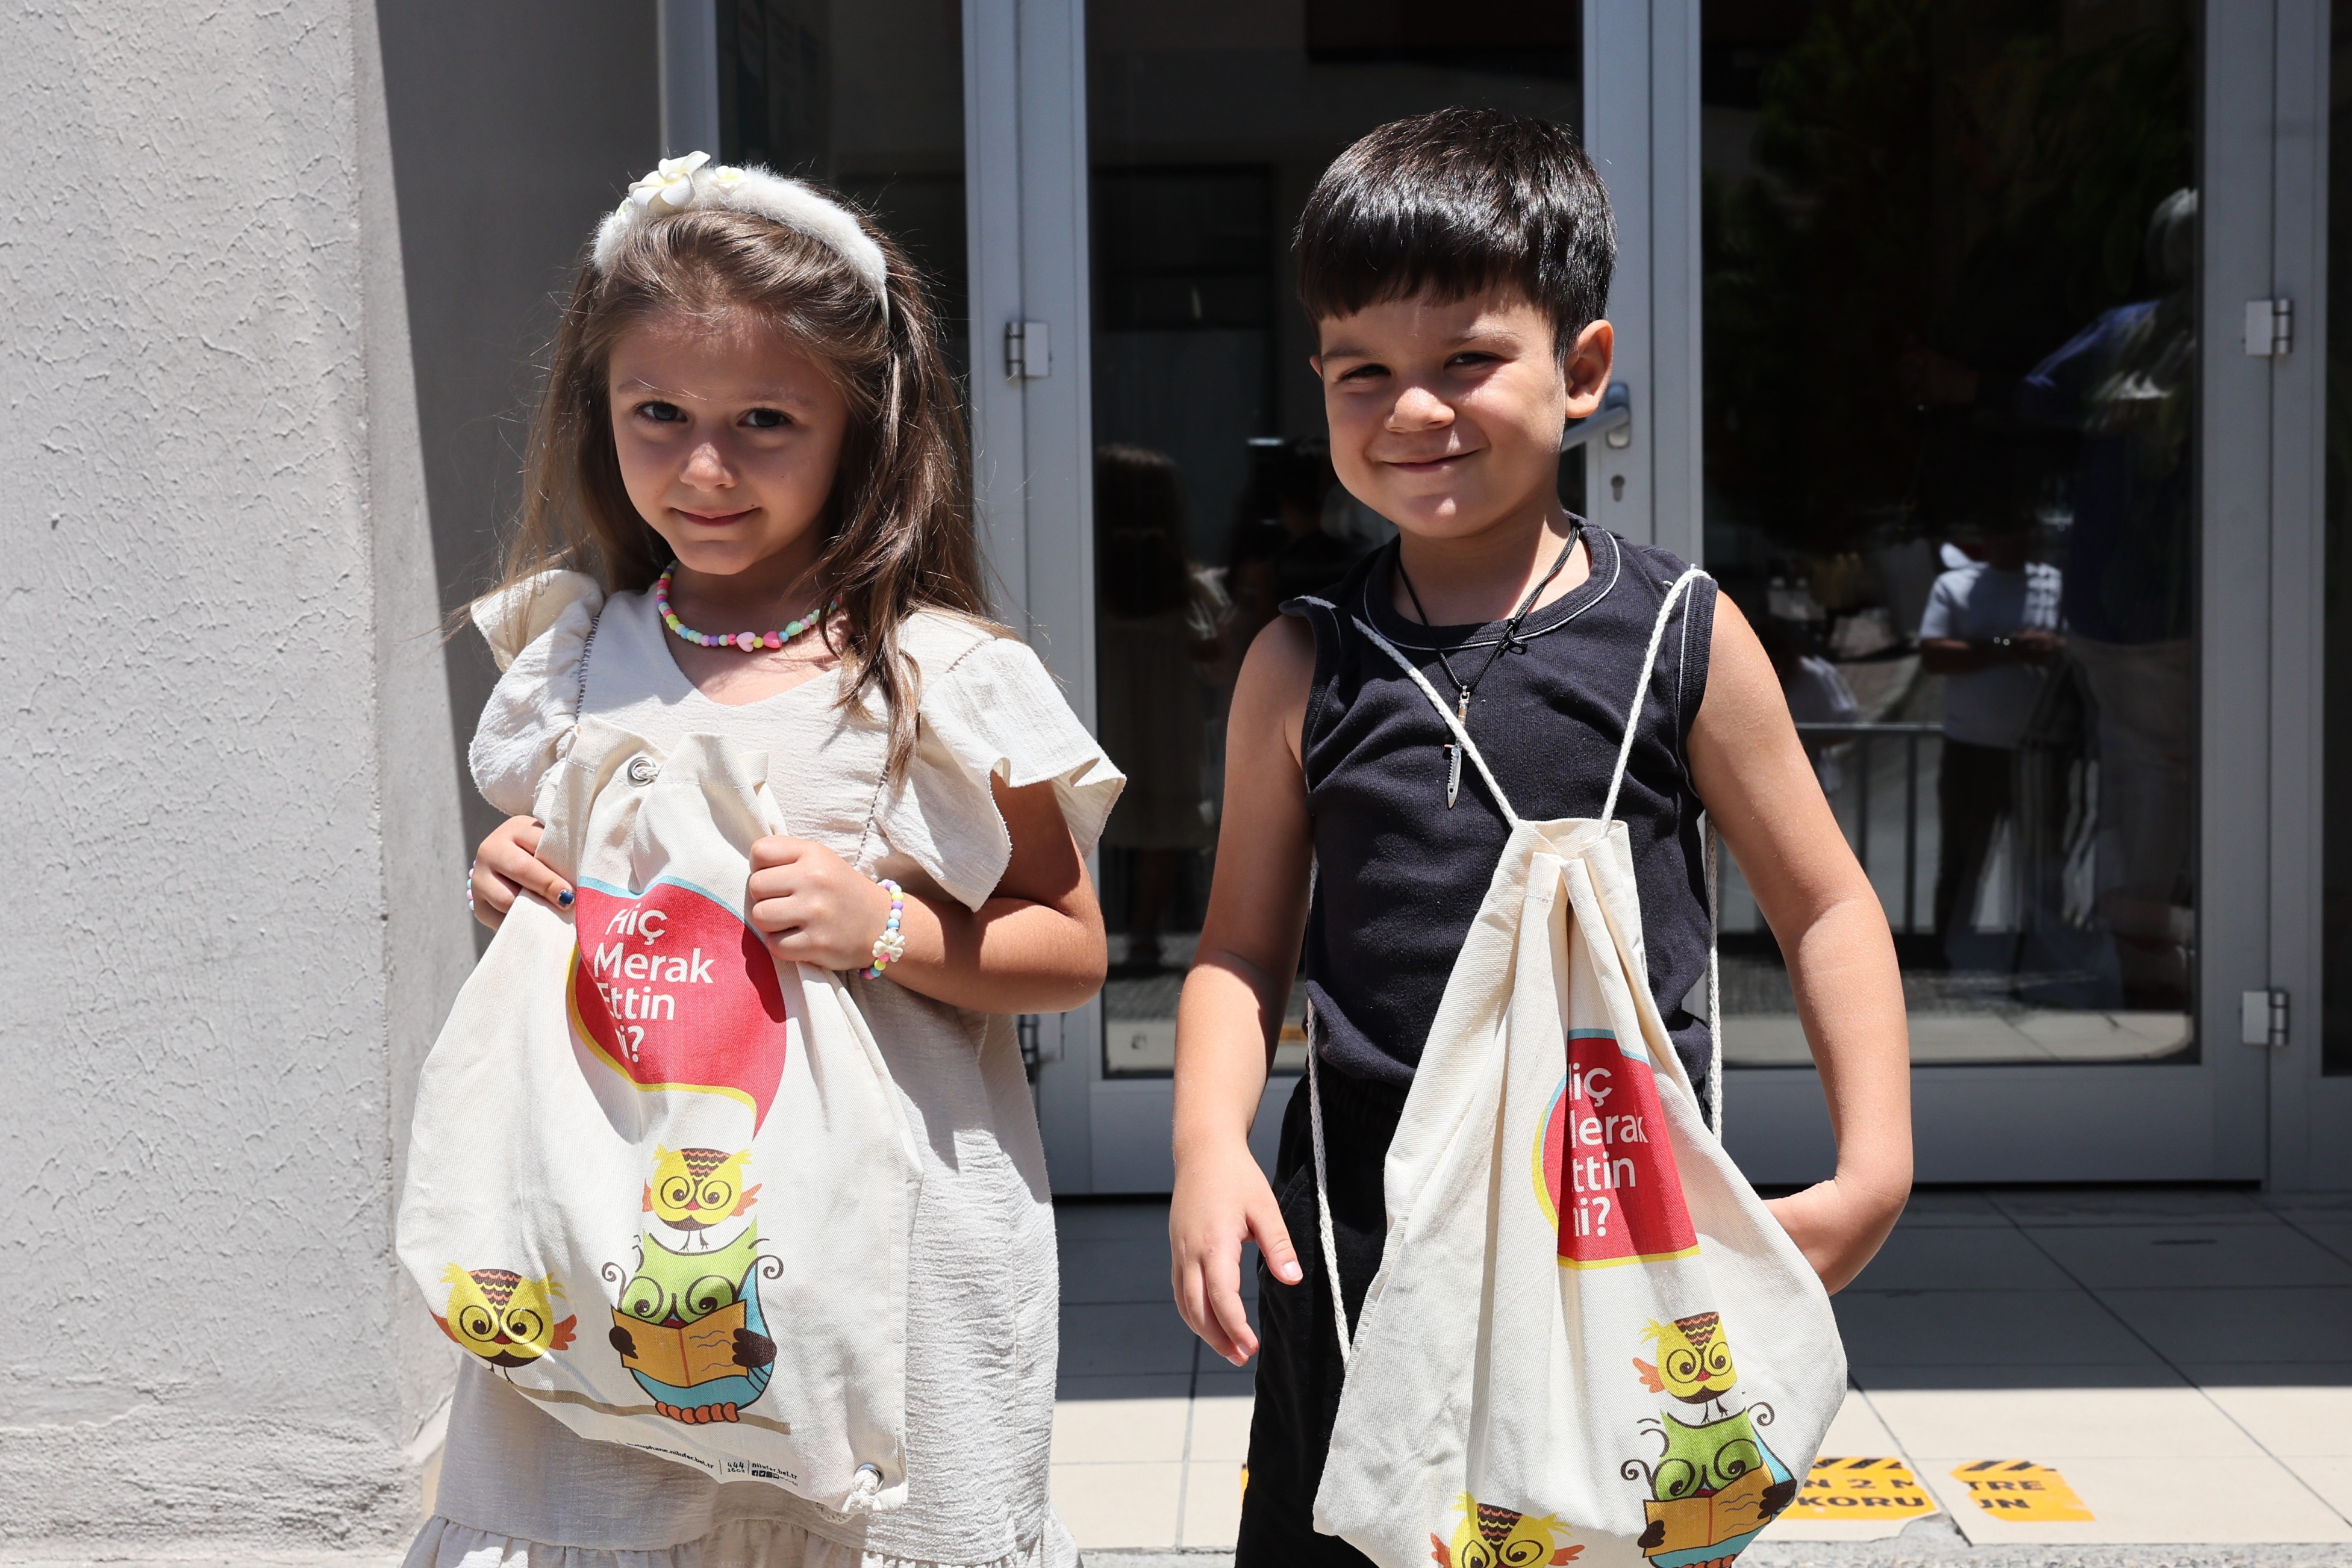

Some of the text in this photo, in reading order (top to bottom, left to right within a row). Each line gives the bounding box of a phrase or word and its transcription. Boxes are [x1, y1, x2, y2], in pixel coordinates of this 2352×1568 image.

[605, 902, 668, 945] Hiç
[594, 942, 714, 983] Merak
[615, 1024, 645, 1063] i?
[1568, 1062, 1612, 1107] iç
[1569, 1109, 1649, 1149] erak
[1571, 1151, 1636, 1192] ttin
[1573, 1196, 1611, 1237] i?
[1797, 1496, 1924, 1507] KORU
[1847, 1478, 1877, 1489] 2
